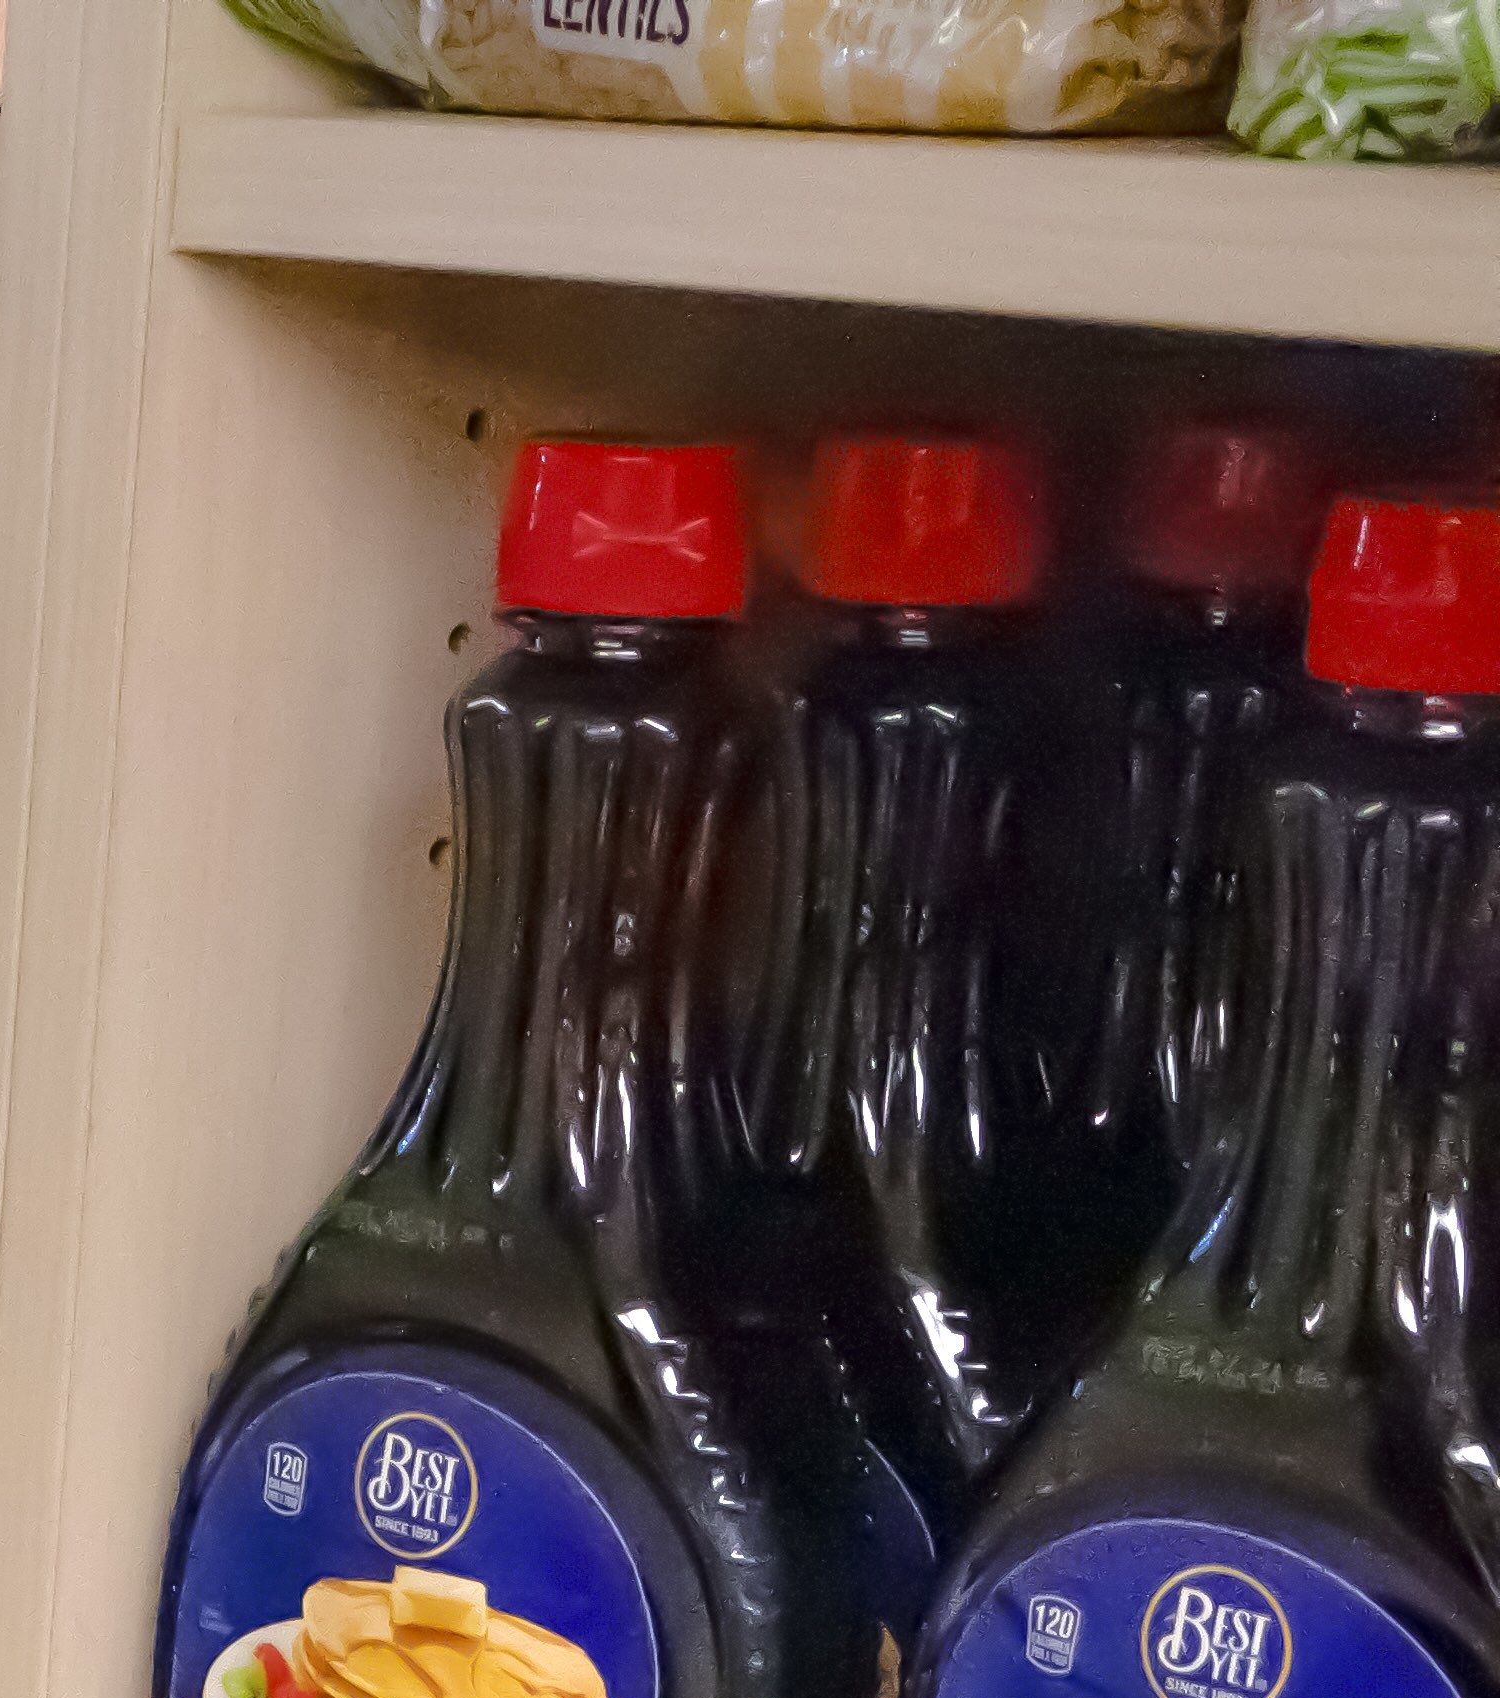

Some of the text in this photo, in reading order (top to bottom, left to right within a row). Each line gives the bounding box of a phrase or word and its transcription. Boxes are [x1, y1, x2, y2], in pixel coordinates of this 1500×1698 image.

[272, 1451, 303, 1483] 120
[367, 1431, 460, 1512] BEST
[408, 1487, 454, 1525] YET
[1035, 1602, 1076, 1640] 120
[1157, 1586, 1272, 1674] BEST
[1209, 1647, 1260, 1690] YET
